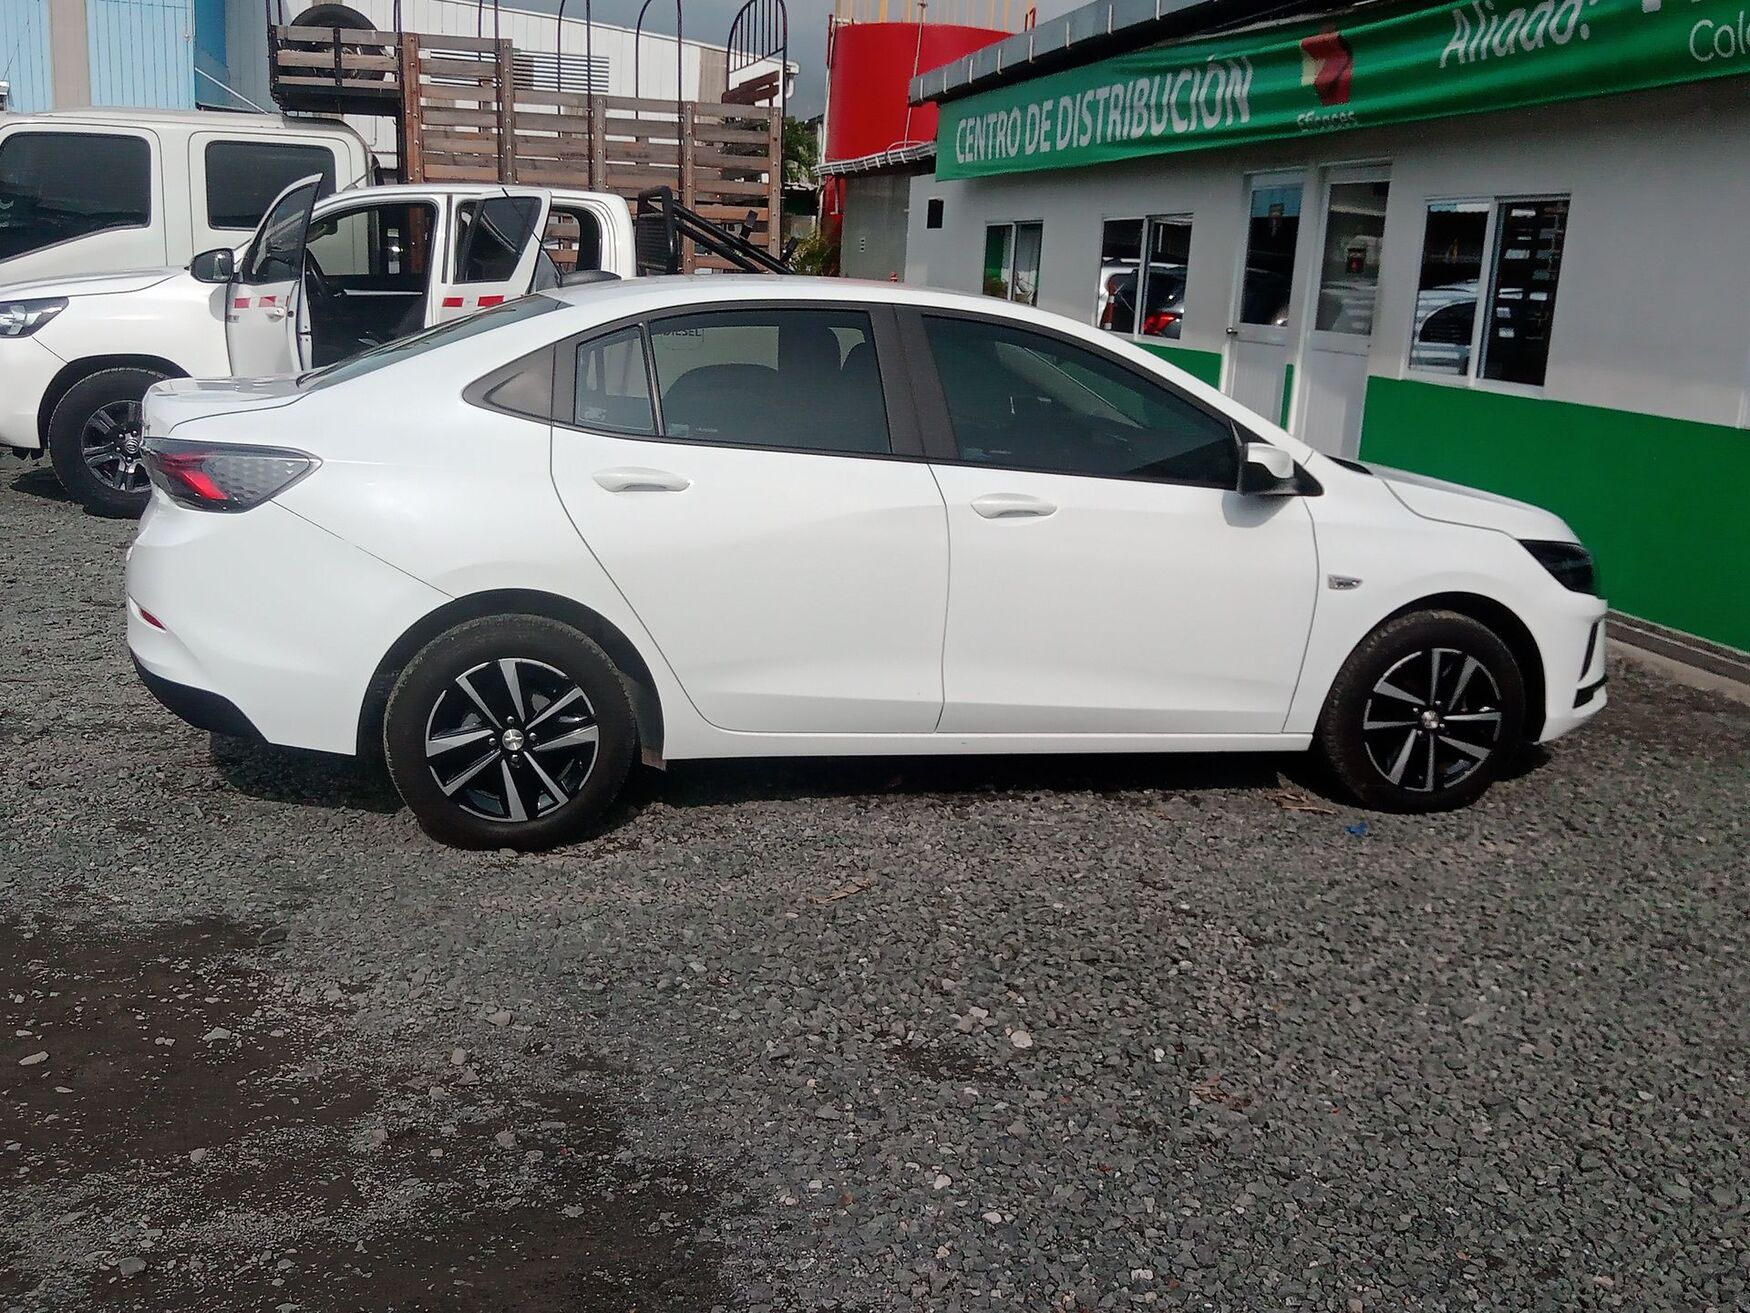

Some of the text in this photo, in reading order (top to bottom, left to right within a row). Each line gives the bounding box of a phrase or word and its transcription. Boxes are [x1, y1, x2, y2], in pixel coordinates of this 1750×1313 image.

[1439, 0, 1591, 68] Aliado:
[955, 54, 1254, 164] CENTRO DE DISTRIBUCIÓN
